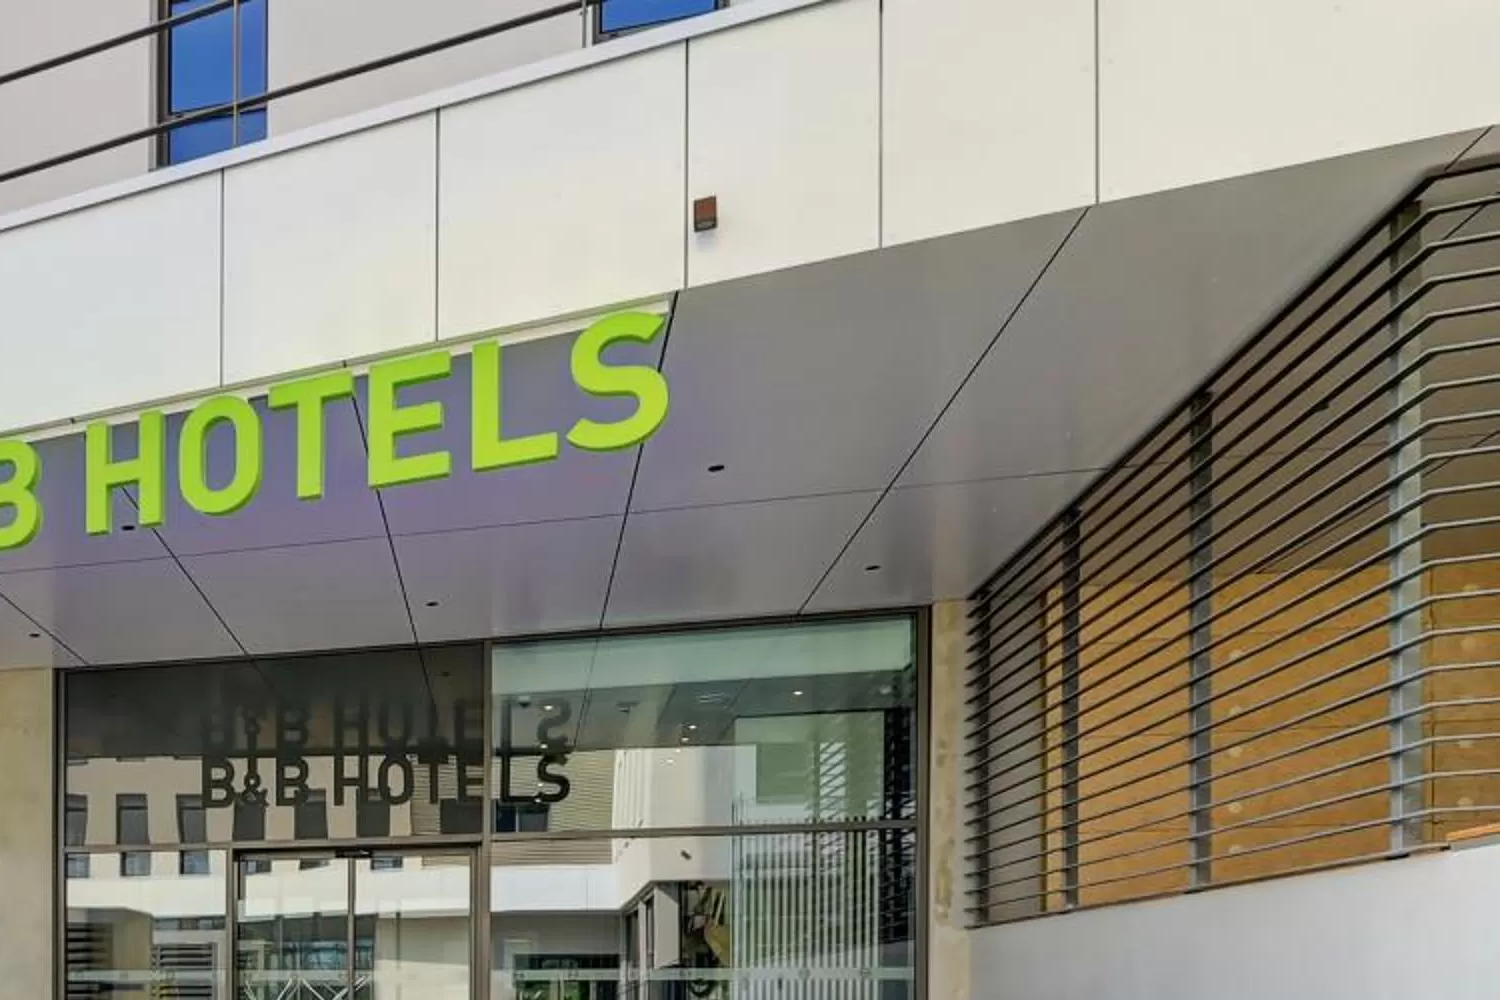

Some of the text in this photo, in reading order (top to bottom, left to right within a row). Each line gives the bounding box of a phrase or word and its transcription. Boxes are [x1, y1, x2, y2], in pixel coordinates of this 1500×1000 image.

[83, 310, 670, 536] HOTELS
[203, 752, 571, 808] B&B HOTELS
